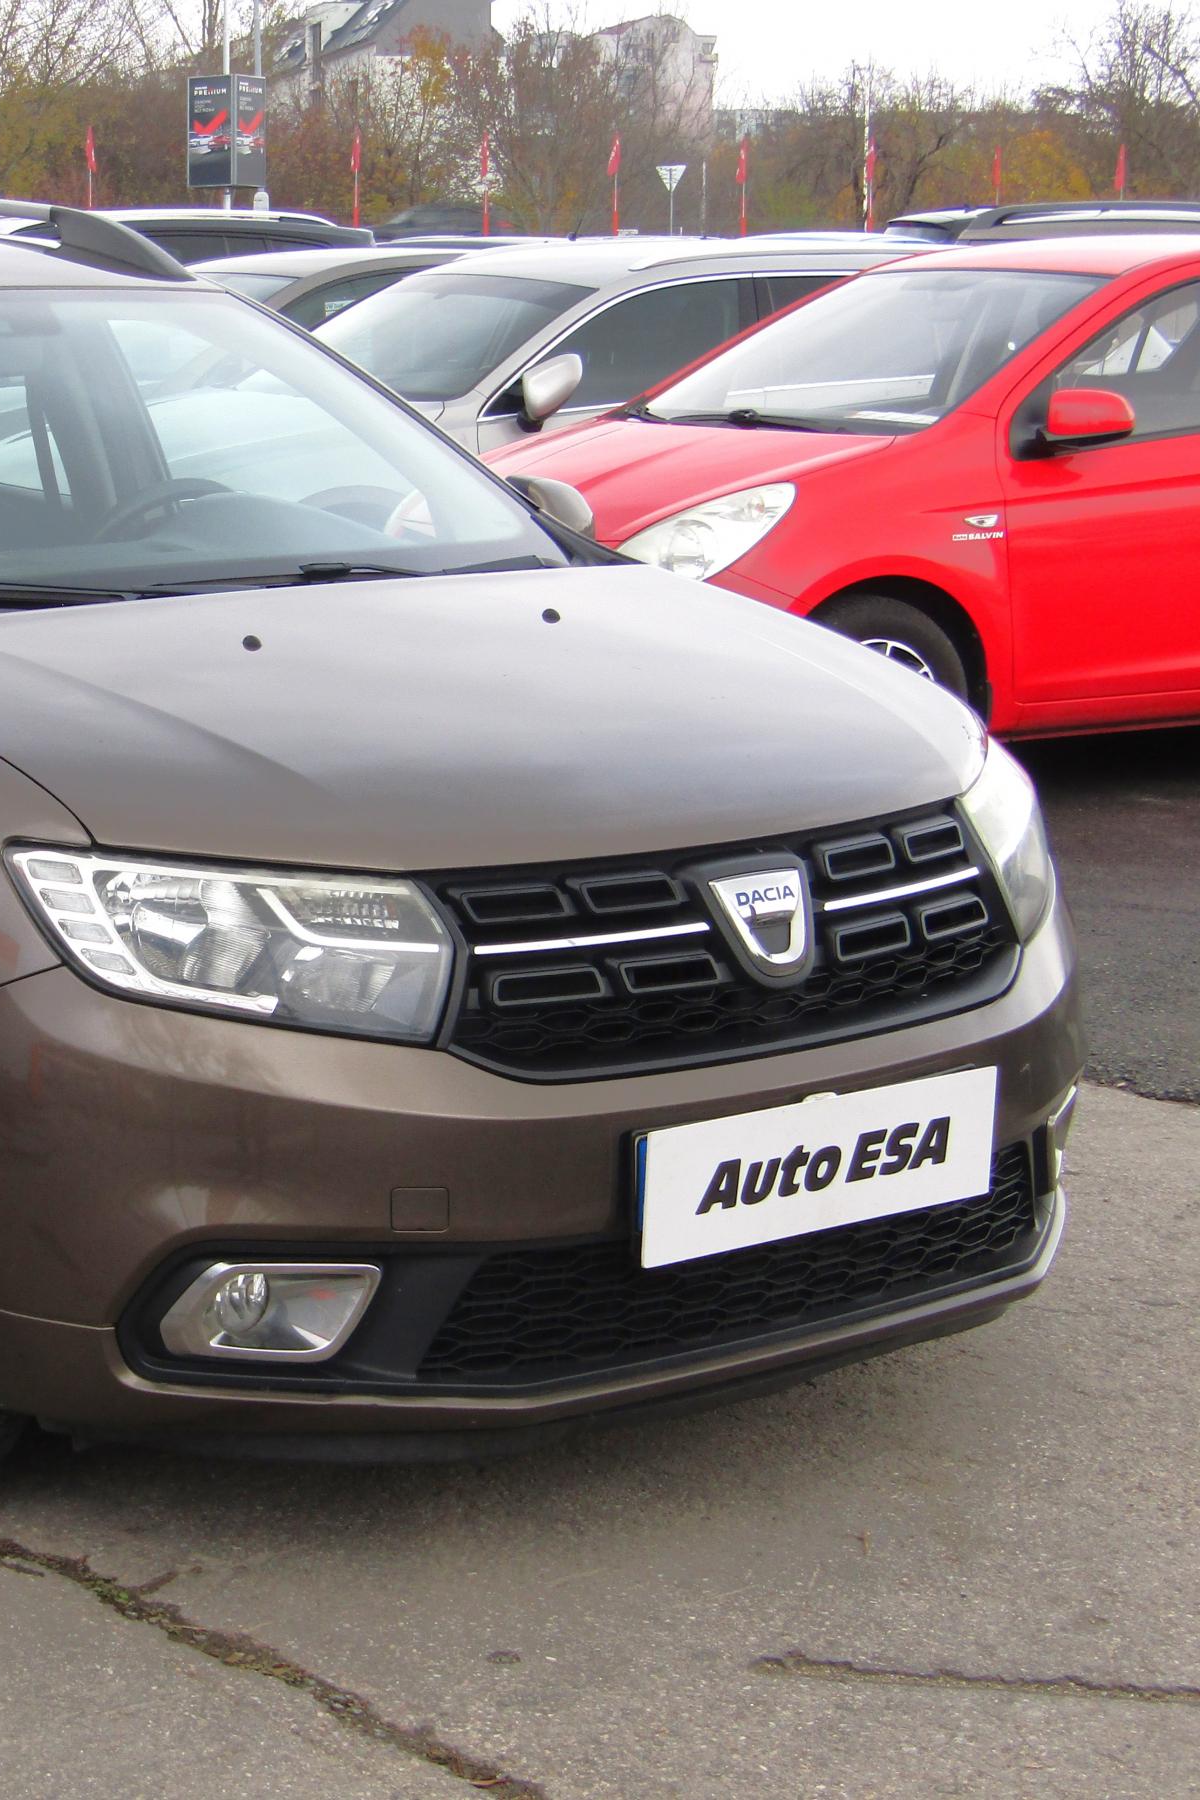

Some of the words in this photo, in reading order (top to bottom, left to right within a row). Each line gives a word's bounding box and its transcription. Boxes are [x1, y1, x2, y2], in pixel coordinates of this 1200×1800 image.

[968, 531, 1004, 541] BALVIN
[735, 885, 795, 906] DACIA
[695, 1144, 841, 1215] Auto
[845, 1116, 951, 1184] ESA
